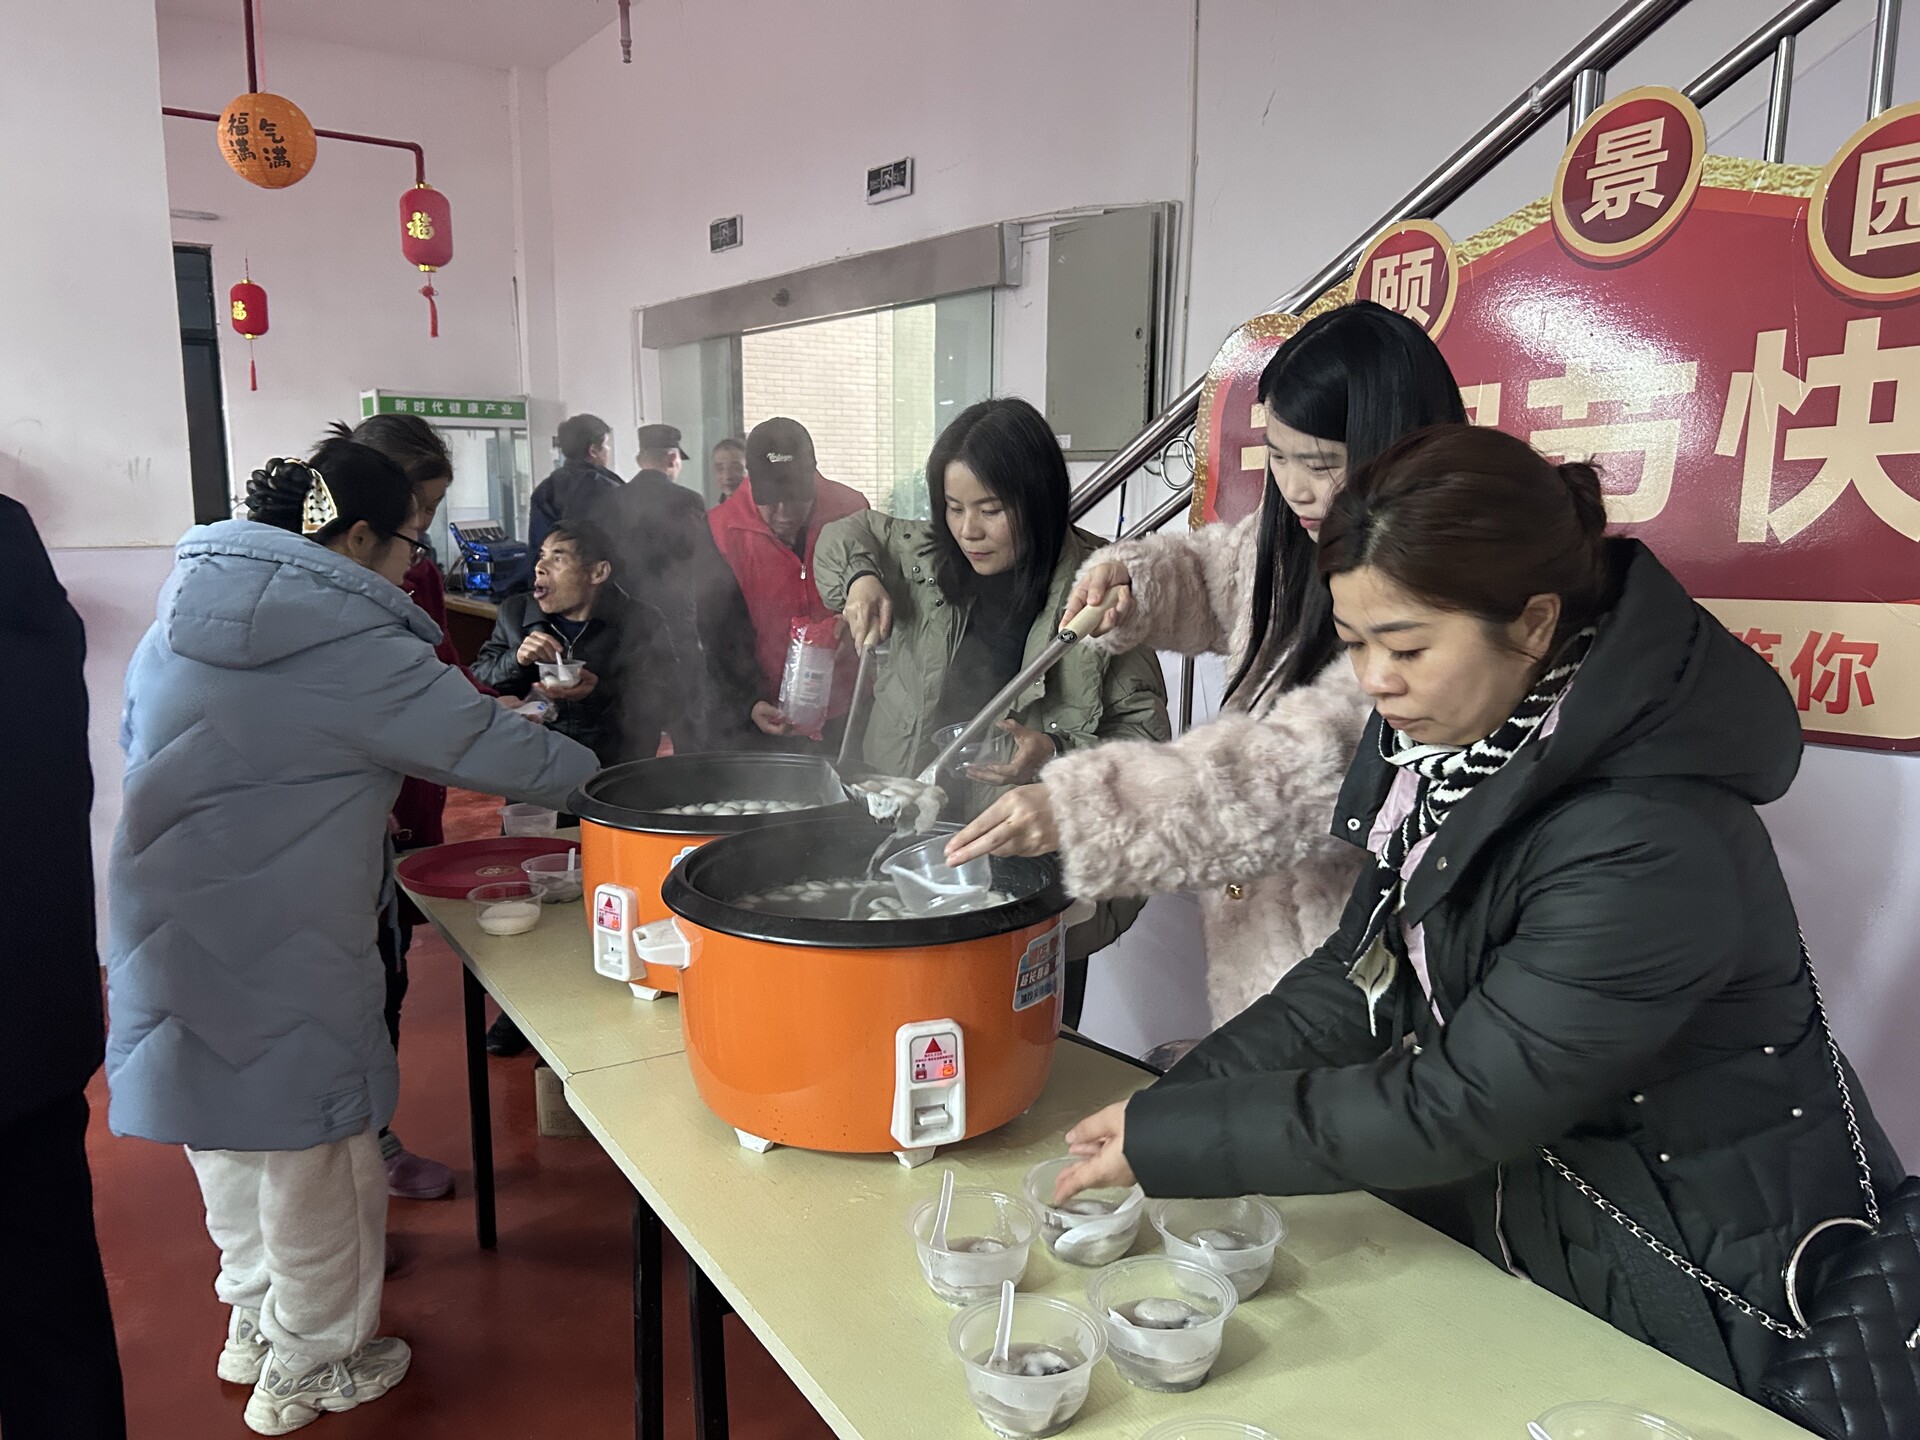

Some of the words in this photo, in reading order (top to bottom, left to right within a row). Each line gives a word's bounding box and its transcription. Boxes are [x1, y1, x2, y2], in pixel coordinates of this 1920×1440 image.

[406, 211, 435, 240] 福
[394, 399, 513, 415] 新时代健康产业
